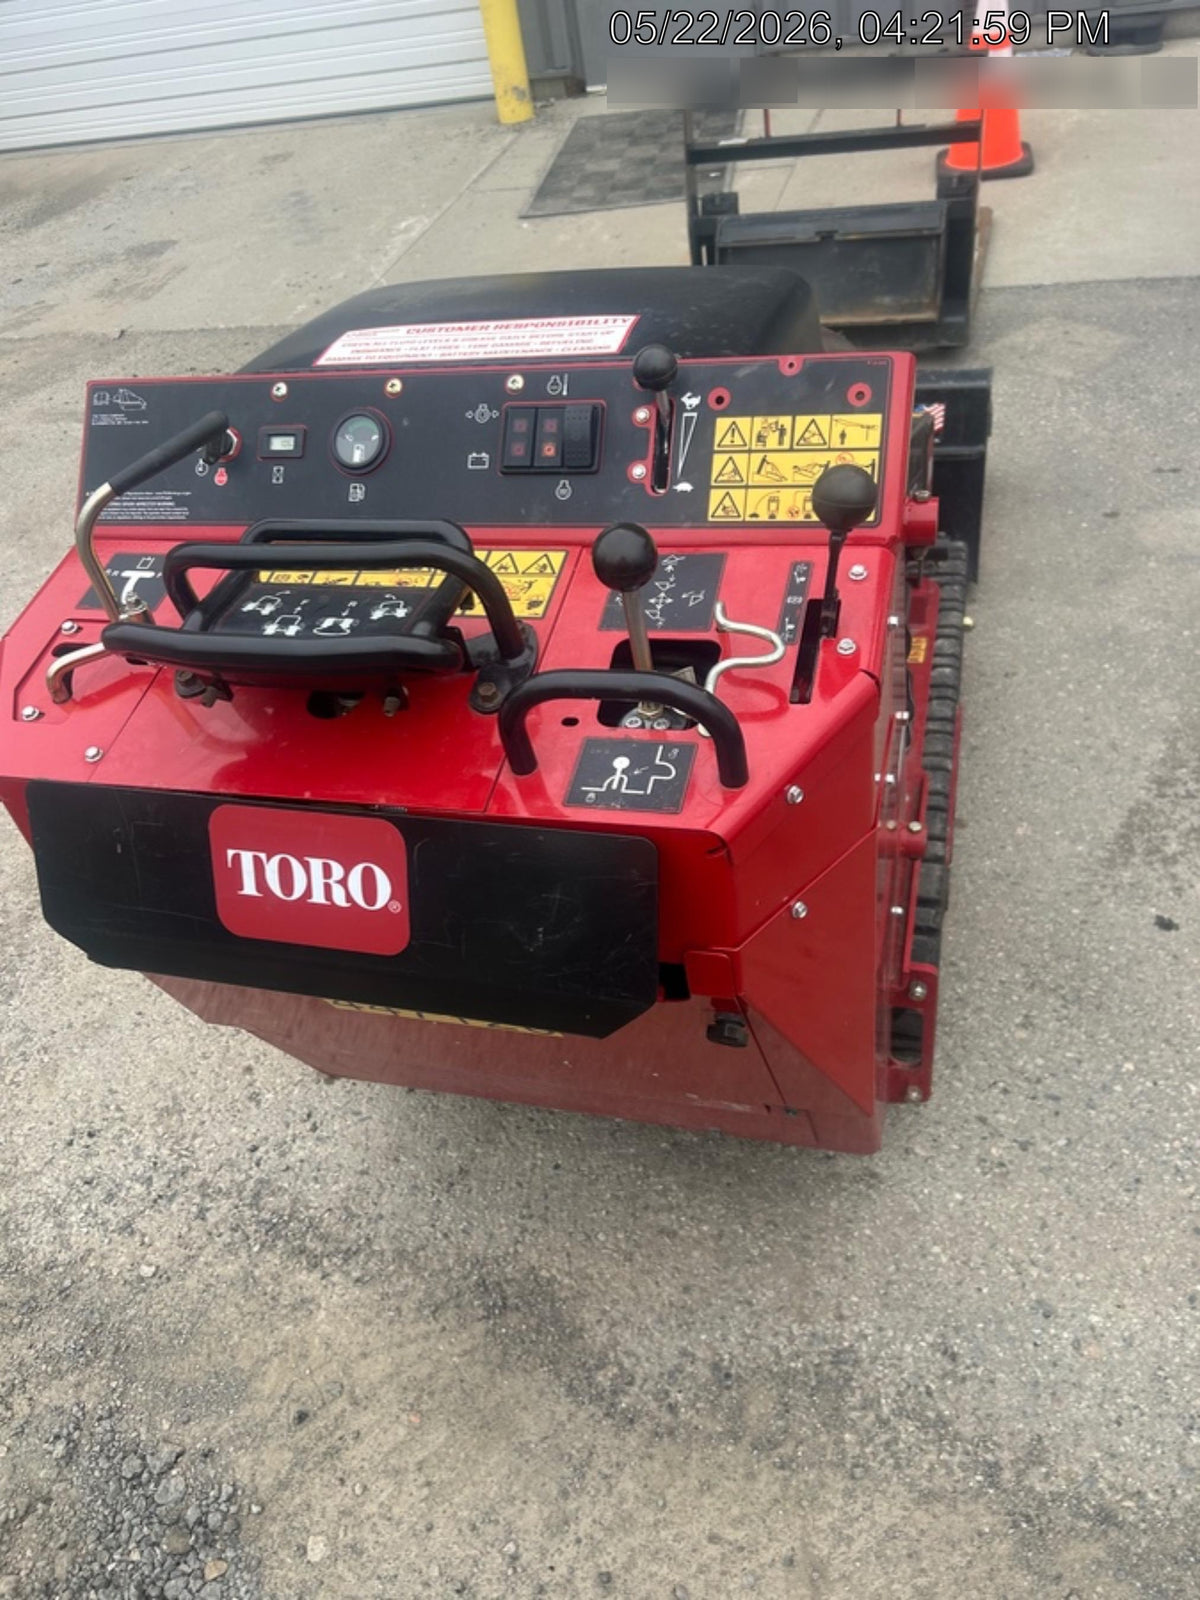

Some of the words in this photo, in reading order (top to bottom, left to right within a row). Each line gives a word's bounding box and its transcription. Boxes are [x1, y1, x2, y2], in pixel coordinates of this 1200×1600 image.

[406, 324, 491, 335] CUSTOMER
[493, 318, 632, 331] RESPONSIBILITY
[226, 848, 392, 911] TORO
